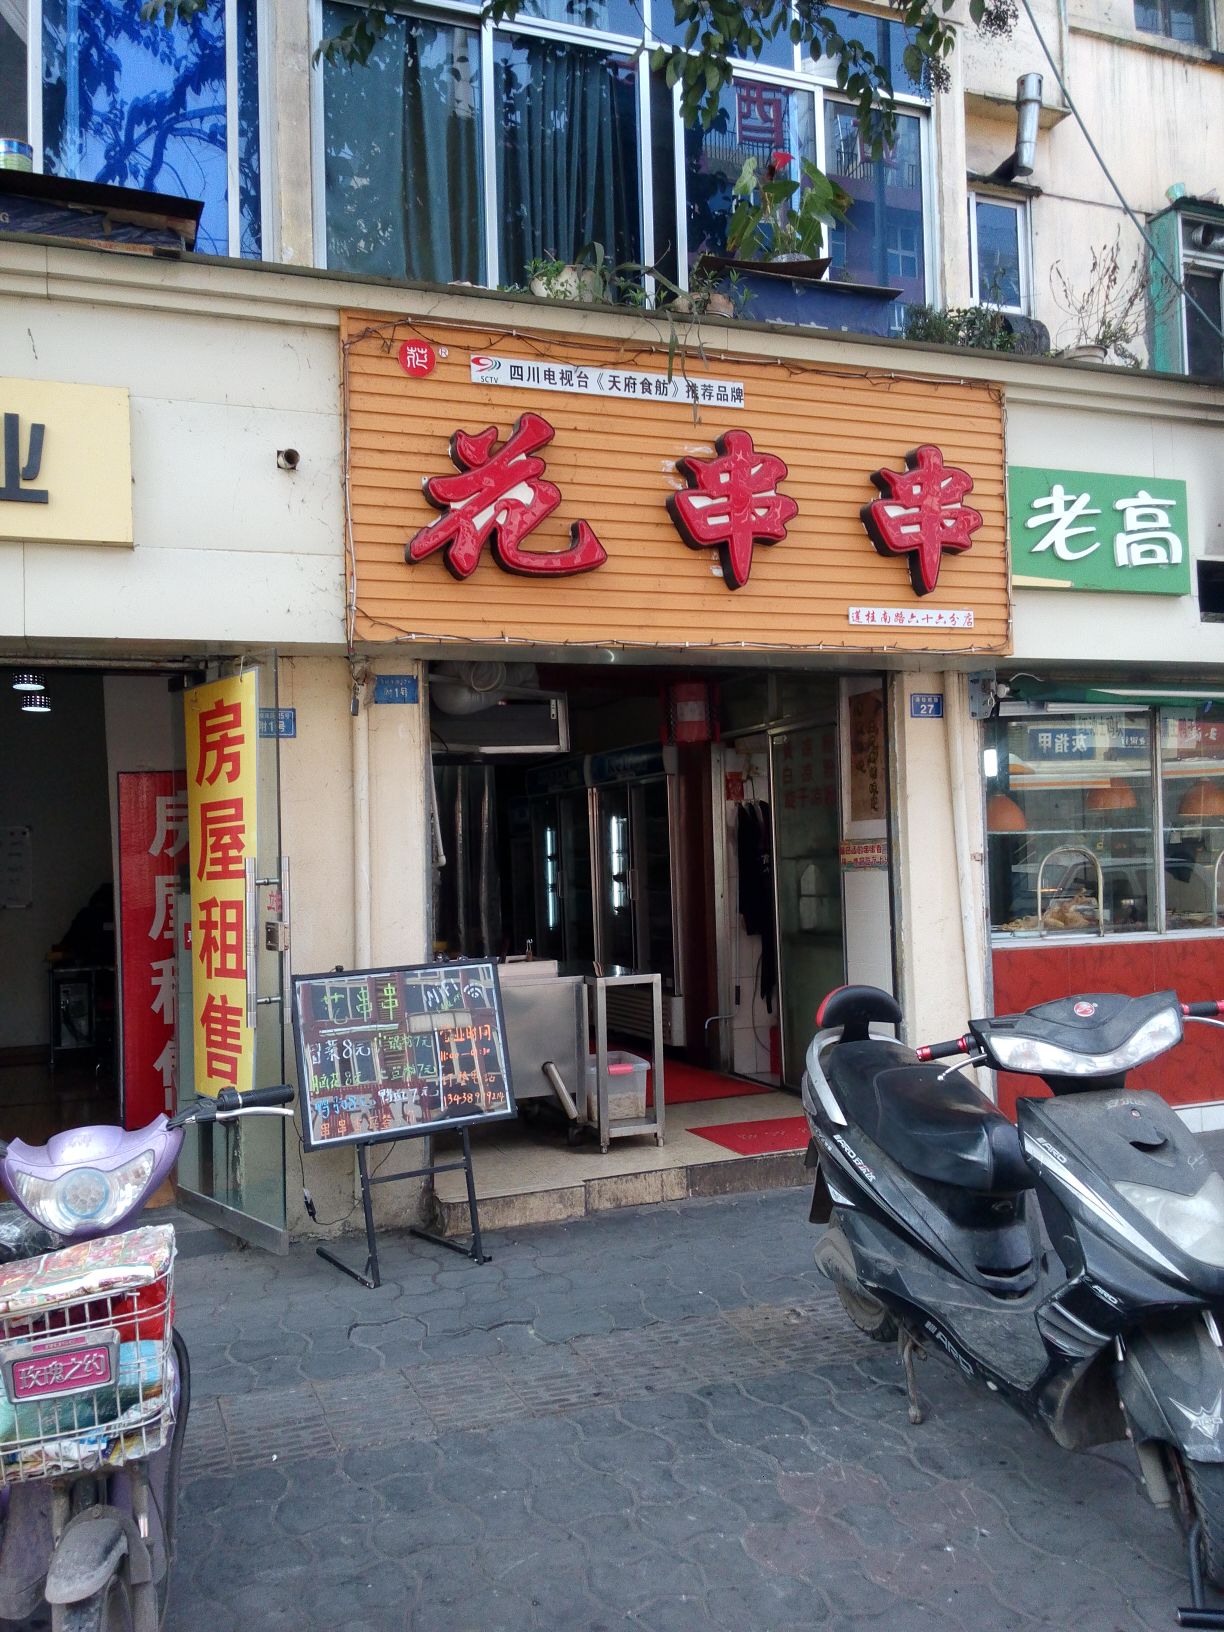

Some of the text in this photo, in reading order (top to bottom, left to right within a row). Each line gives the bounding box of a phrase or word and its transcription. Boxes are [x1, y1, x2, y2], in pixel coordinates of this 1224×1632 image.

[480, 375, 499, 384] SCTV
[404, 411, 983, 597] 花串串
[1024, 484, 1183, 568] 老高
[920, 704, 935, 714] 27
[195, 698, 246, 1086] 房屋租售
[19, 1352, 106, 1390] 玫瑰之约
